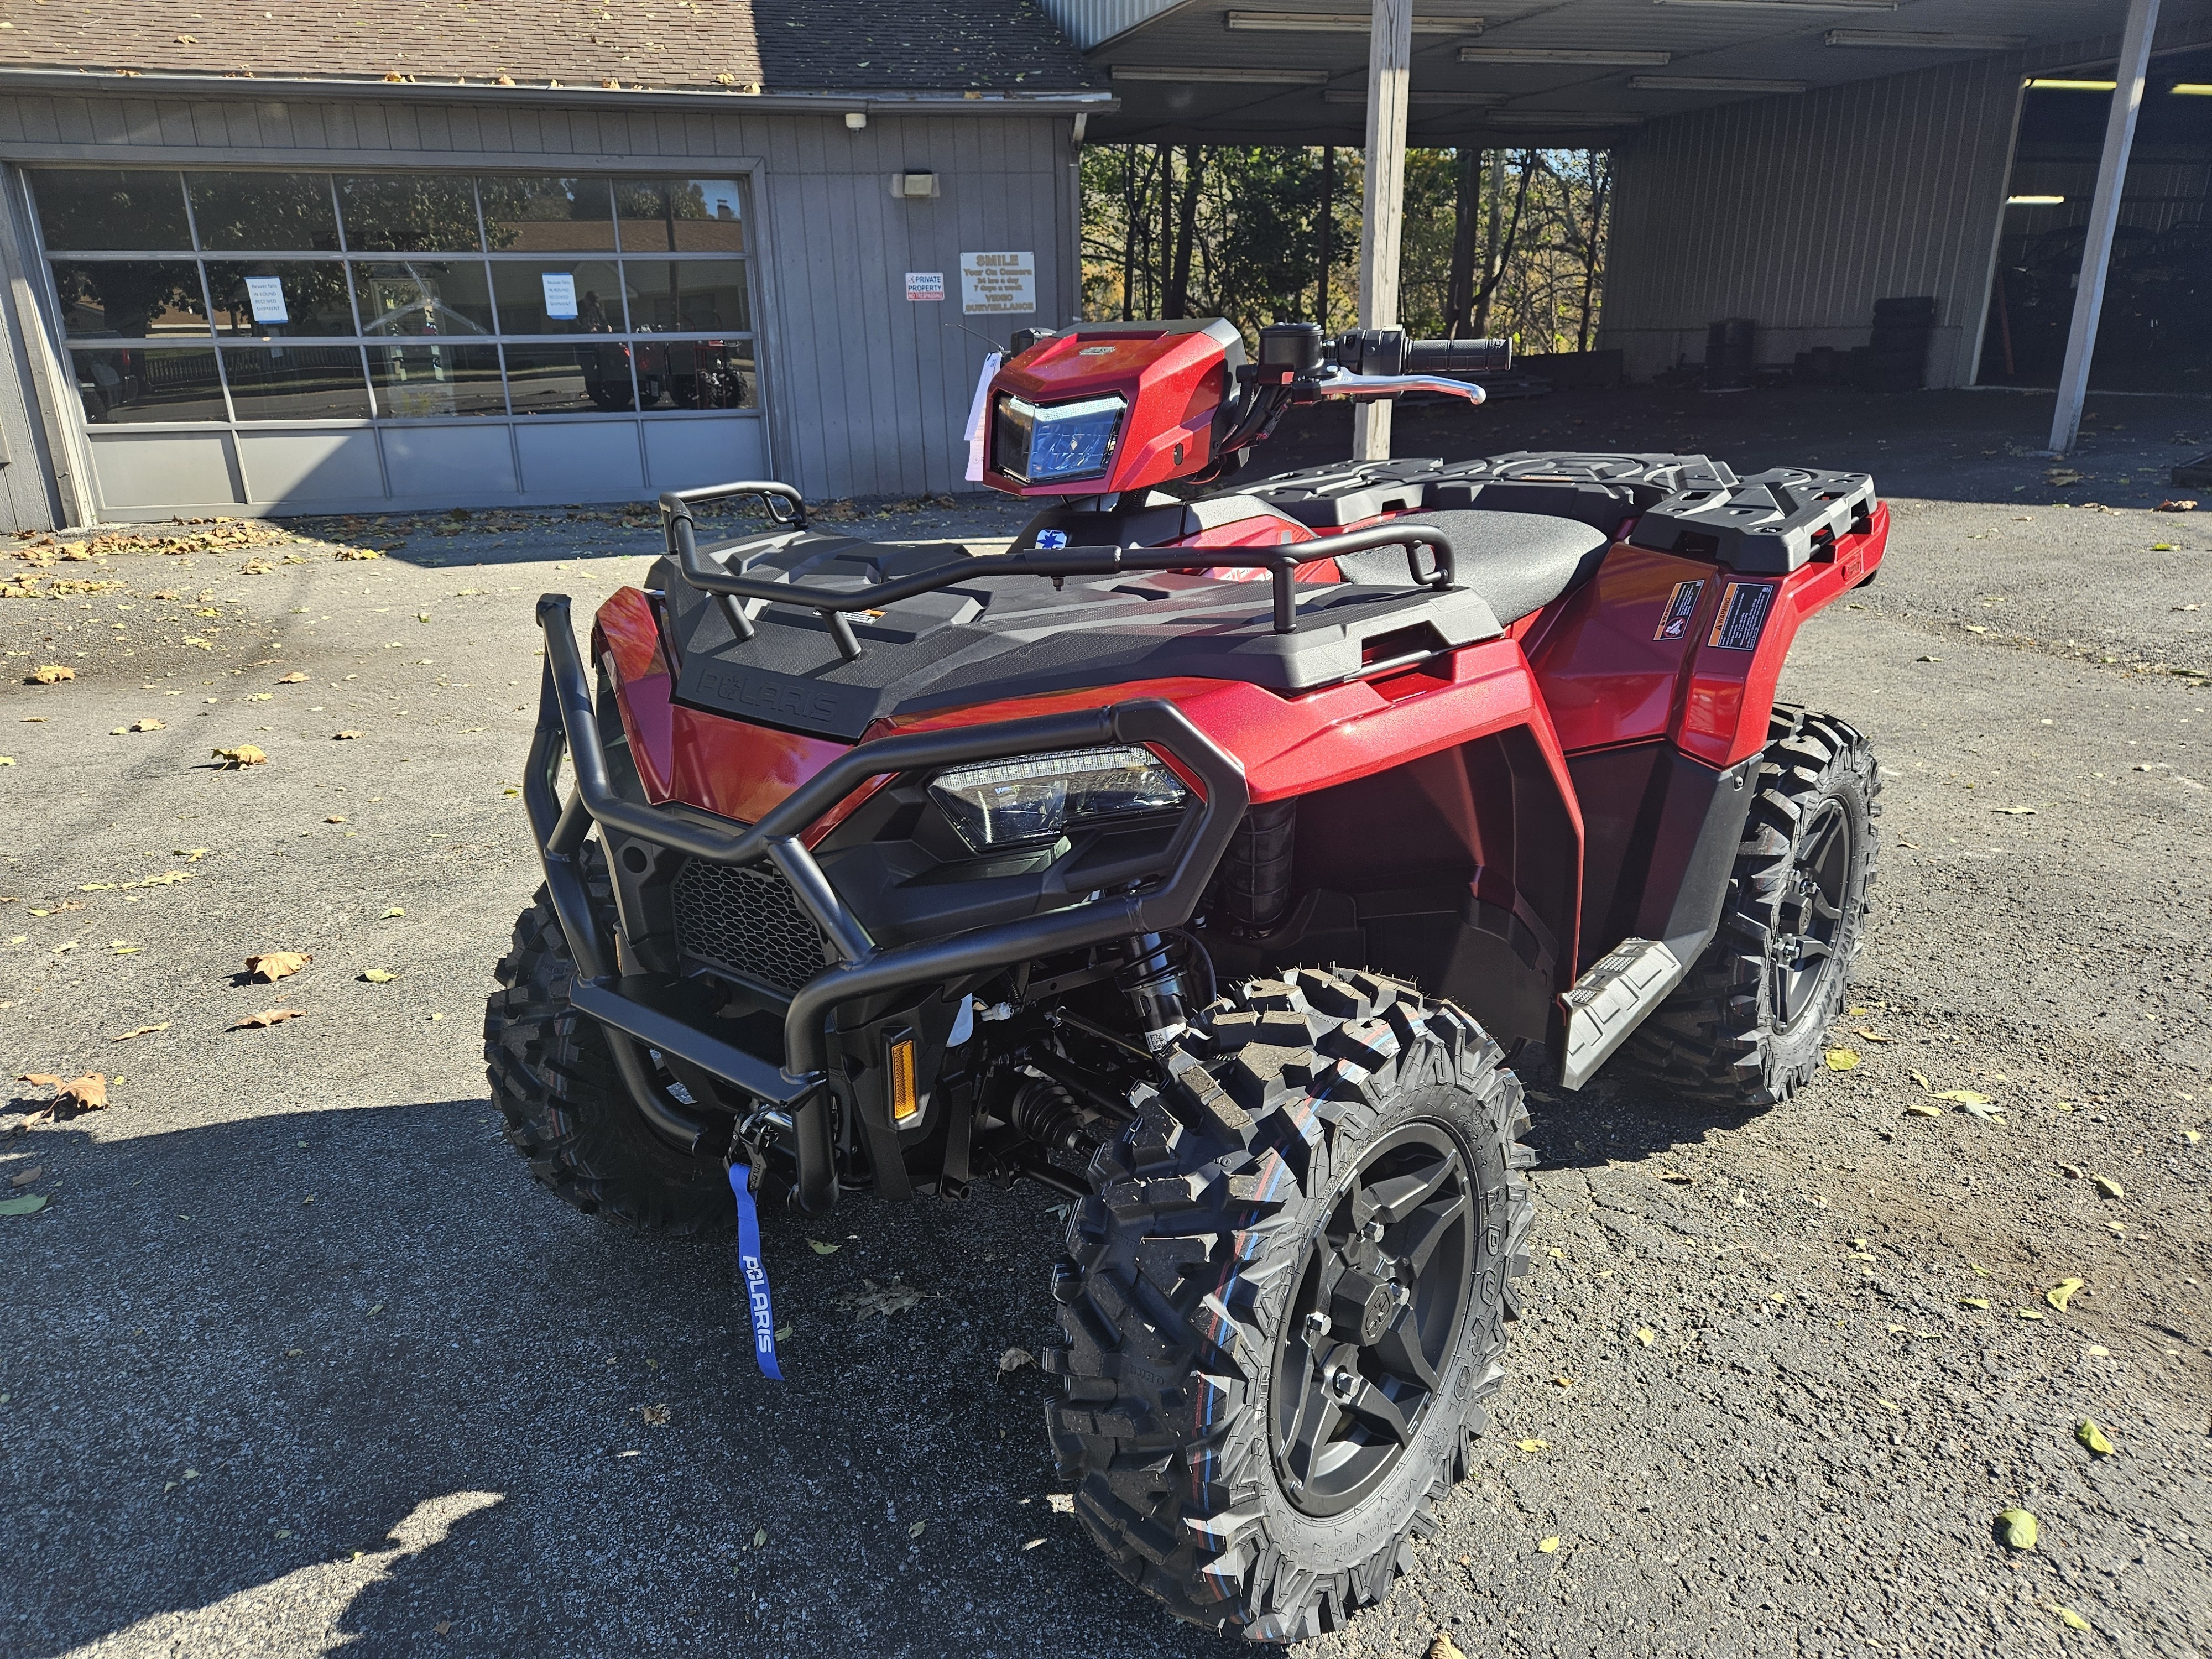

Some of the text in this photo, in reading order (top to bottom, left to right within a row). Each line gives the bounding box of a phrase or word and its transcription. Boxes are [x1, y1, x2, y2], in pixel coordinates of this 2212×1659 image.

[963, 268, 983, 276] Your
[977, 254, 1019, 266] SMILE
[1662, 596, 1675, 622] WARNING
[1717, 597, 1731, 624] WARNING
[696, 667, 838, 722] POLARIS
[743, 1255, 772, 1354] POLARIS
[1454, 1223, 1501, 1401] DURO
